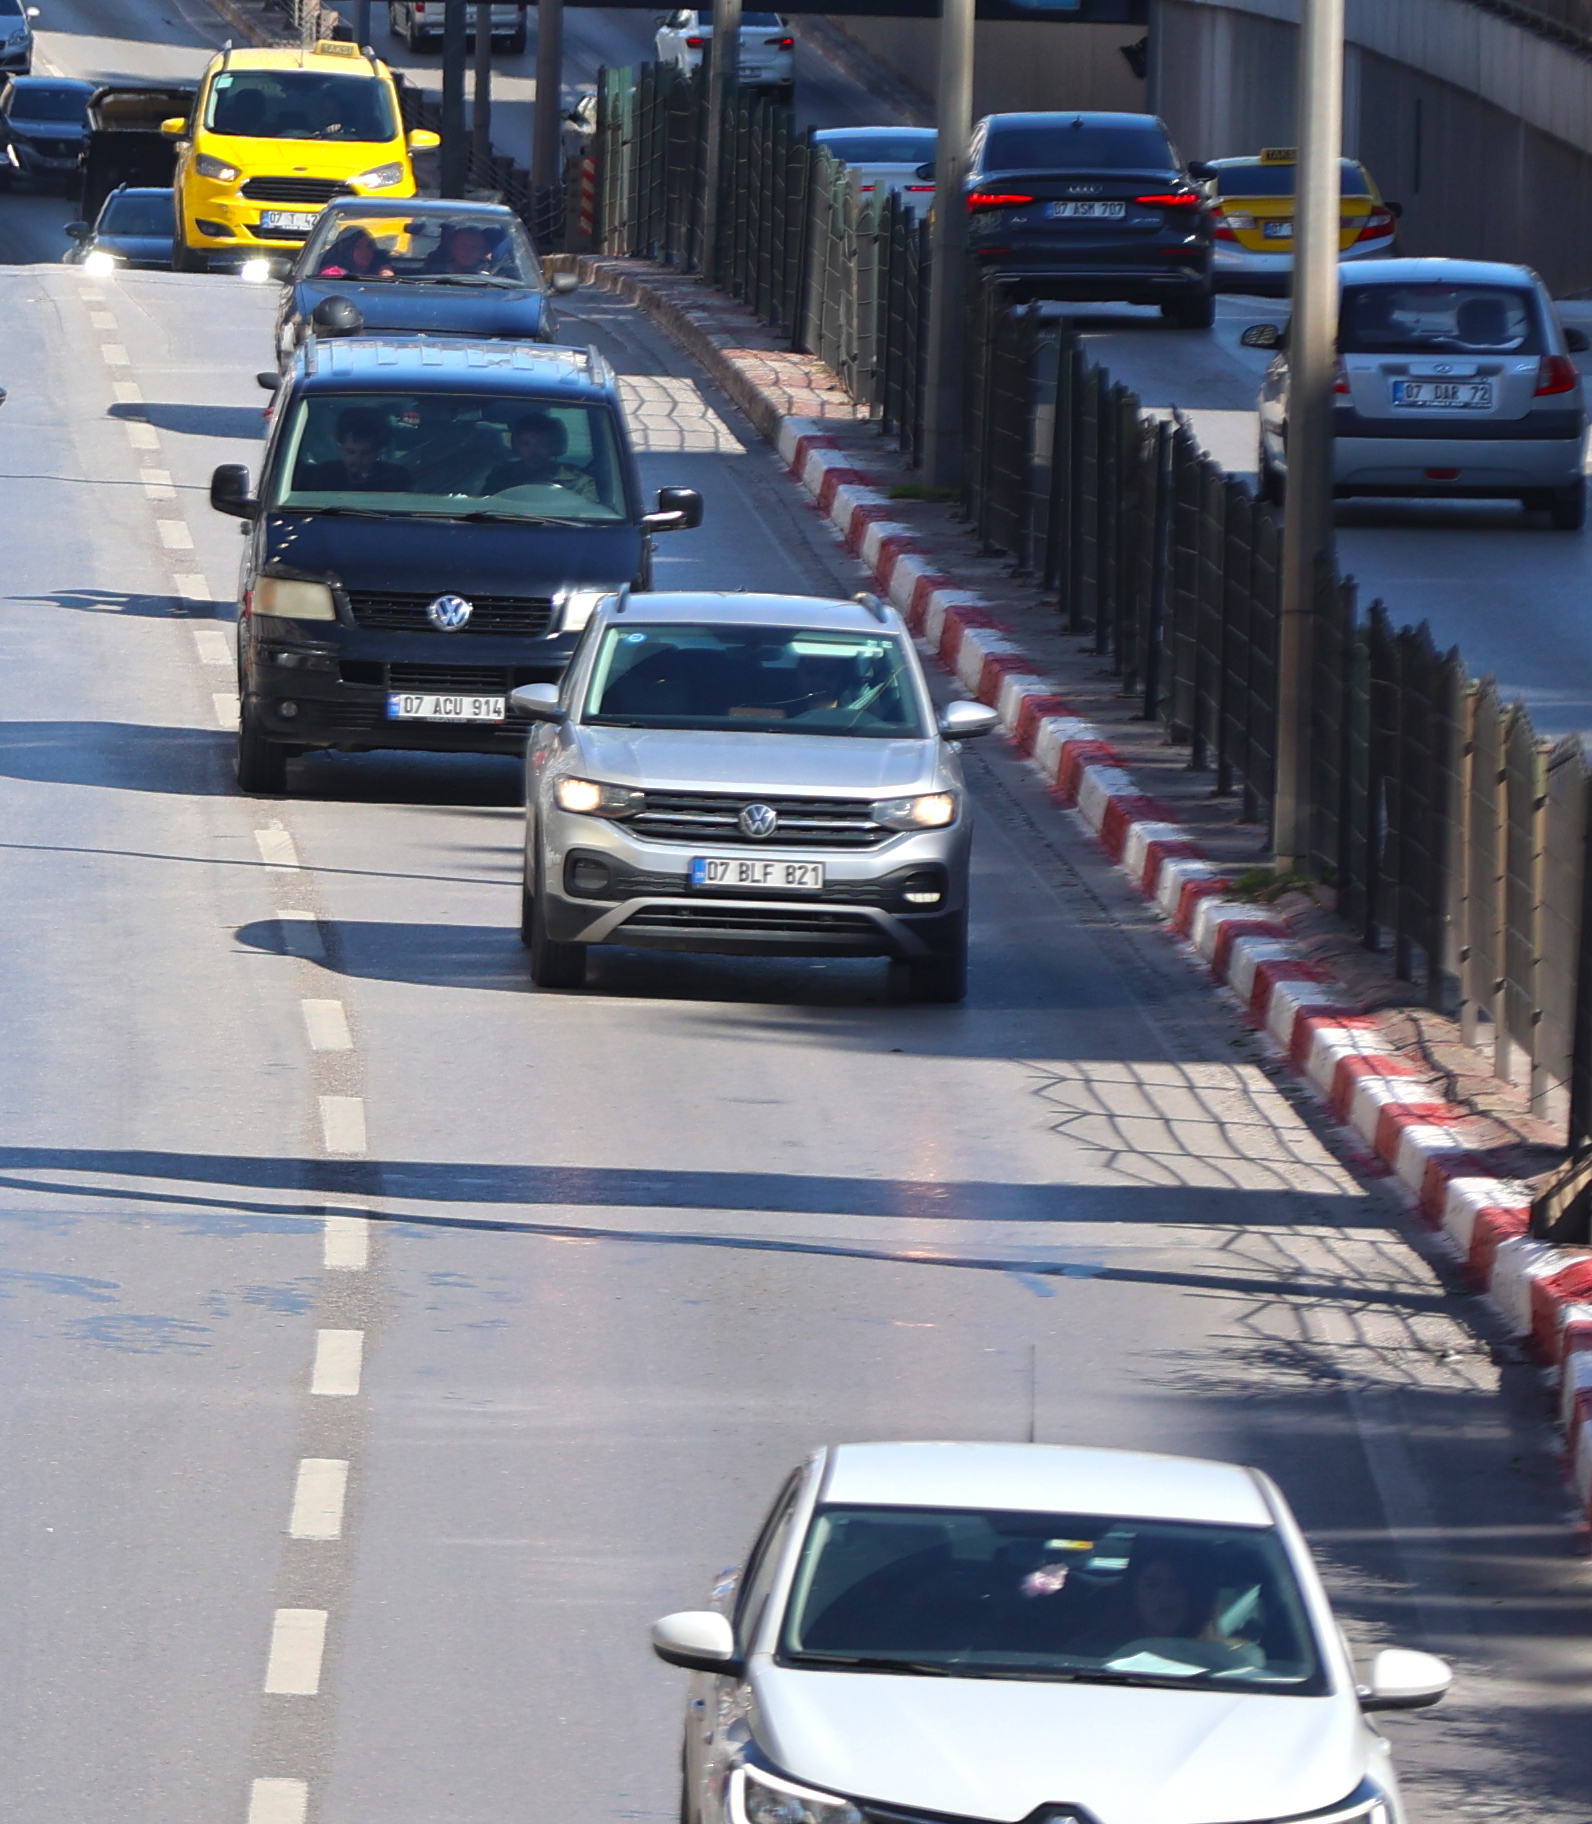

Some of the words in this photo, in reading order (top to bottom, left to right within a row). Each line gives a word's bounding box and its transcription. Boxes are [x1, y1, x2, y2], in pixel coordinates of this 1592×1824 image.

[269, 212, 282, 224] 07
[1405, 383, 1422, 399] 07
[403, 696, 424, 714] 07
[433, 697, 464, 716] ACU
[472, 699, 503, 717] 914
[707, 860, 730, 882] 07
[738, 862, 775, 884] BLF
[785, 864, 820, 886] 821
